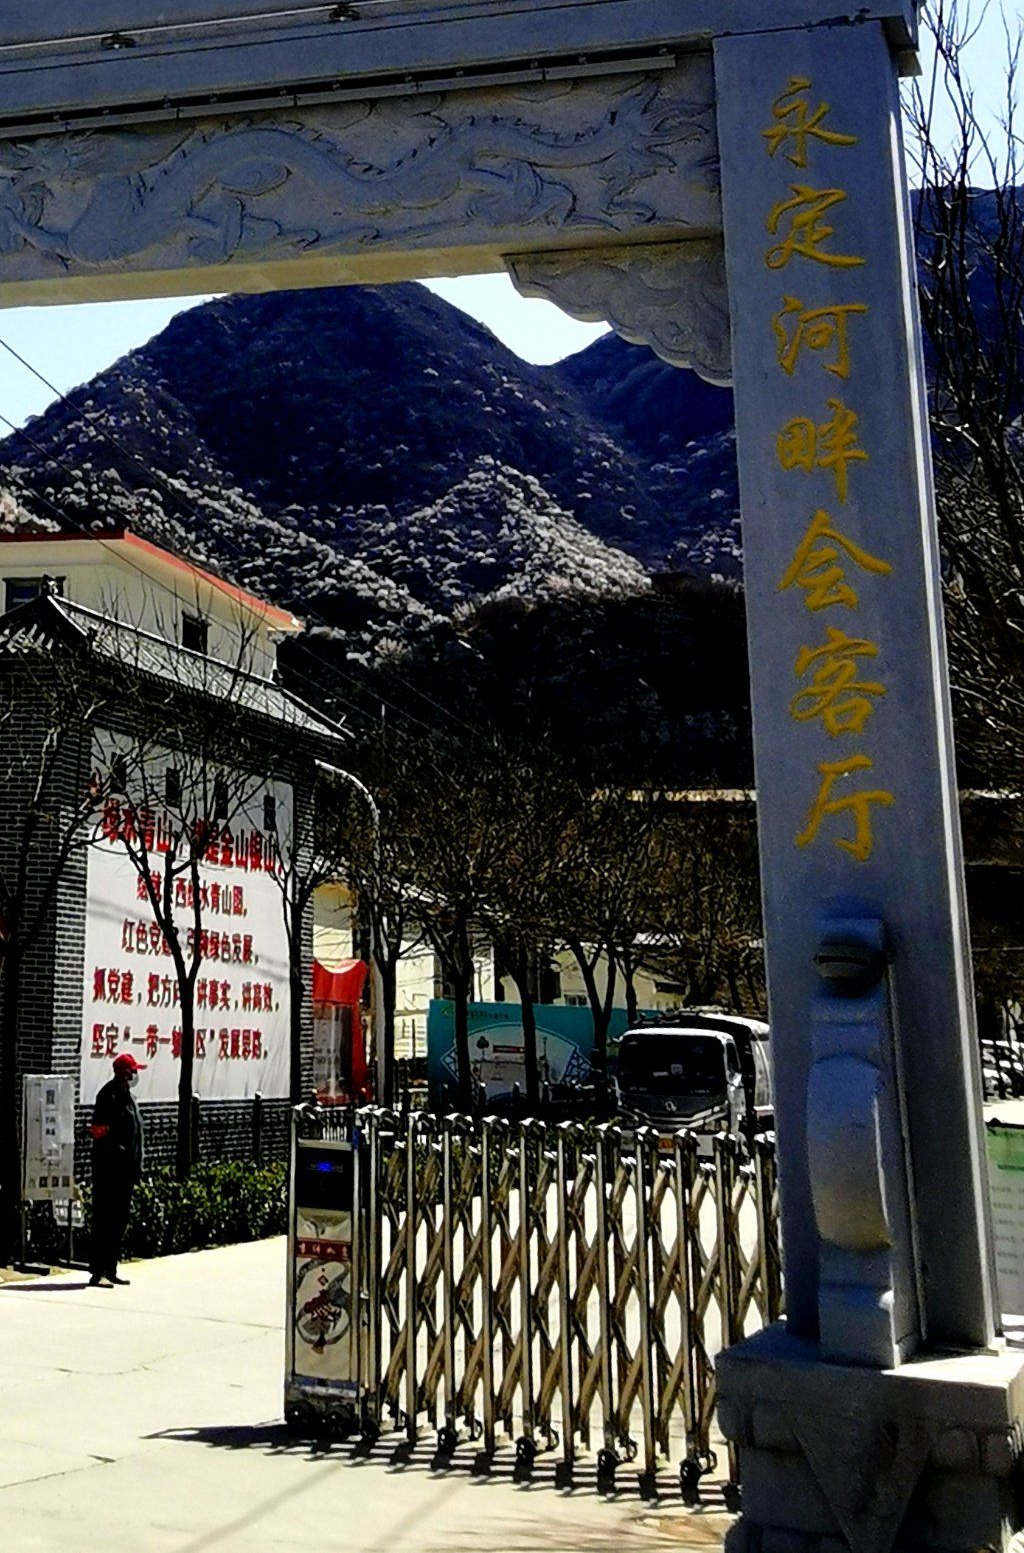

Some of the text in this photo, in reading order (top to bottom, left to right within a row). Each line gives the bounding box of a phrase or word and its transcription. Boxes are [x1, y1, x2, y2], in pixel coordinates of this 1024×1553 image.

[761, 76, 895, 862] 永定河畔会客厅
